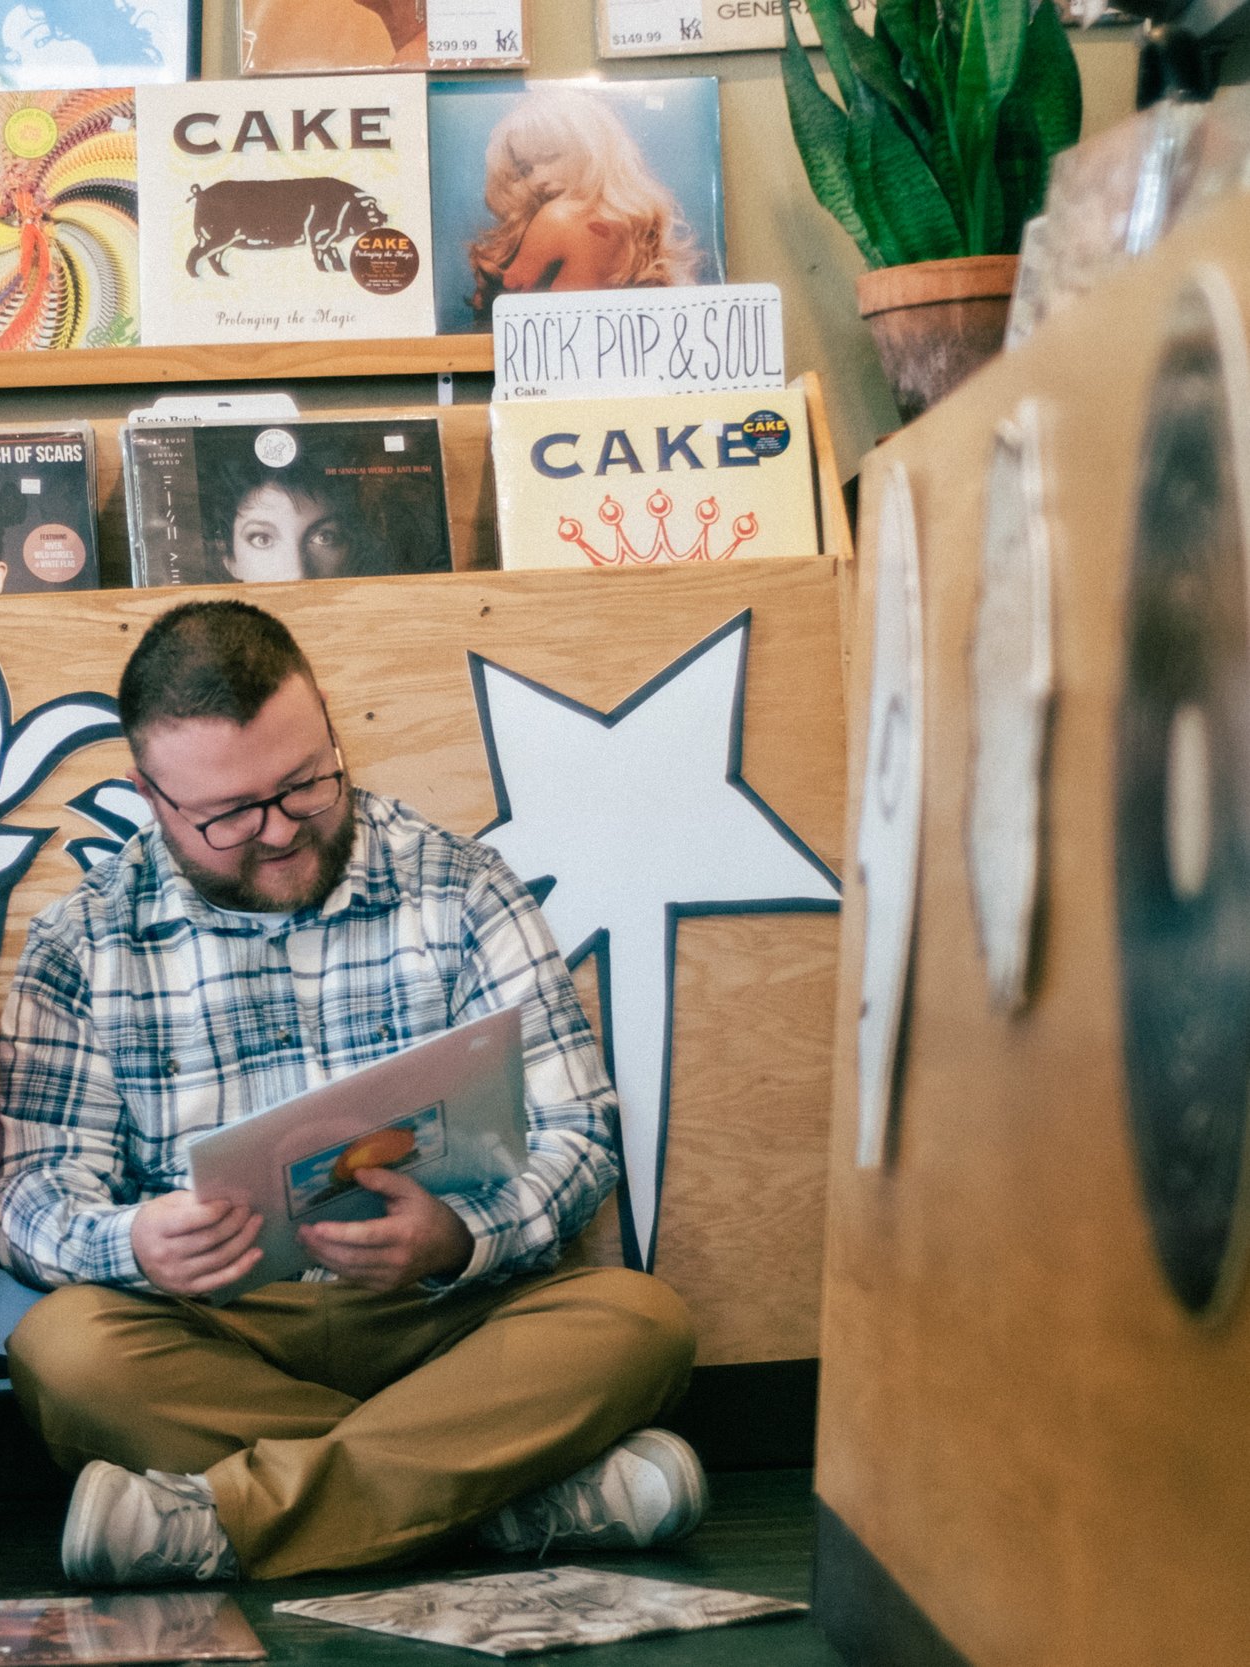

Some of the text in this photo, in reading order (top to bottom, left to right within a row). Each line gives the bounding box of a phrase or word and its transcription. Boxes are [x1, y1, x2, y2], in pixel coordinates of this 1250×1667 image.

[429, 40, 477, 51] $299.99
[612, 32, 661, 45] $149.99
[173, 107, 391, 155] CAKE
[358, 237, 409, 250] CAKE
[216, 308, 357, 330] Prolonging the Magic
[505, 317, 583, 382] ROCK
[668, 312, 697, 379] &
[703, 304, 781, 381] SOUL
[514, 386, 547, 397] Cake
[742, 420, 787, 433] CAKE
[14, 446, 32, 463] OF
[36, 445, 83, 462] SCARS
[530, 422, 760, 479] CAKE
